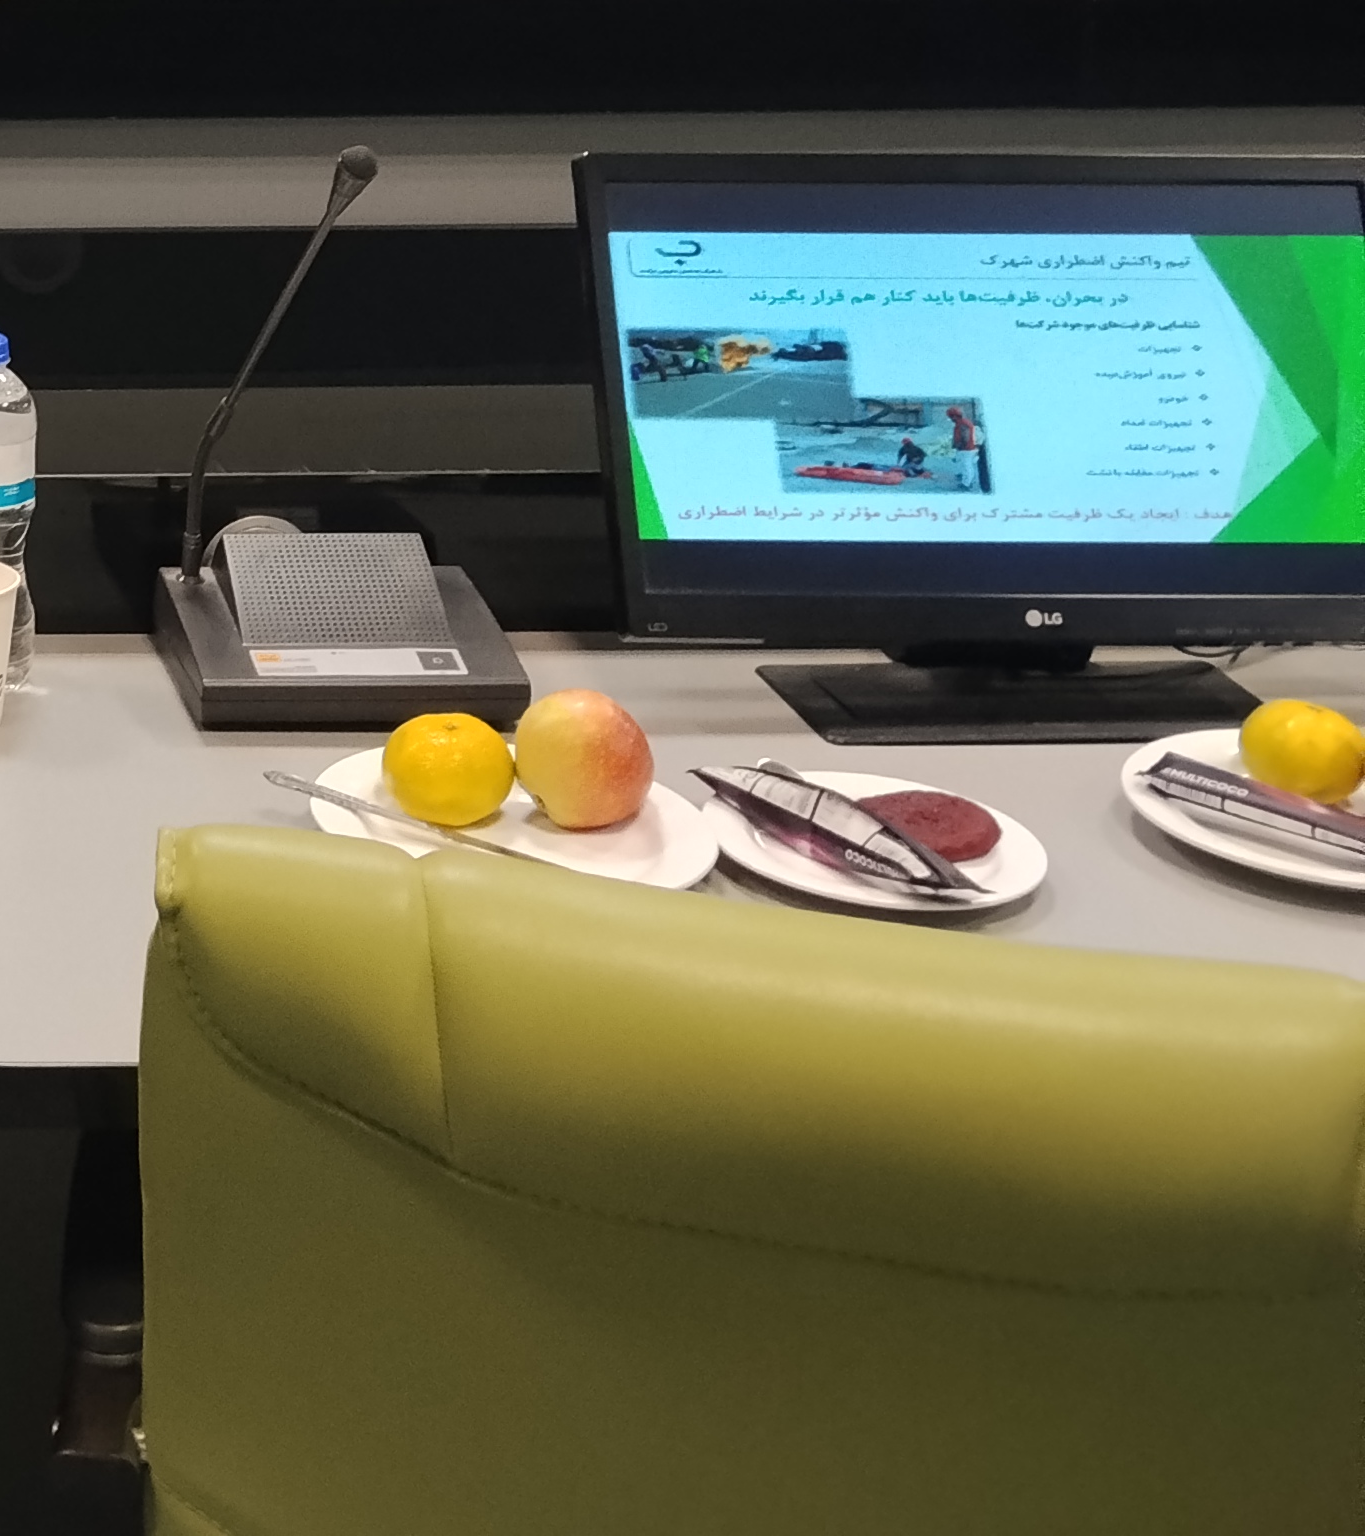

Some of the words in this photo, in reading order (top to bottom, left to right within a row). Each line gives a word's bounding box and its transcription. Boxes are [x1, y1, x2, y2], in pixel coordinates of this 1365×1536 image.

[980, 254, 1034, 270] شهرک
[1037, 254, 1106, 270] اضطراری
[1109, 254, 1162, 271] واکنش
[1165, 255, 1191, 270] تیم
[748, 288, 806, 306] بگیرند
[810, 289, 845, 306] قرار
[850, 292, 877, 306] هم
[882, 289, 917, 306] کنار
[921, 290, 955, 306] باید
[1109, 293, 1129, 308] در
[1158, 320, 1201, 332] شناسایی
[677, 504, 747, 521] اضطراری
[753, 505, 803, 522] شرایط
[807, 508, 825, 522] در
[885, 506, 939, 522] واکنش
[942, 507, 977, 523] برای
[981, 507, 1044, 523] مشترک
[1047, 507, 1103, 523] ظرفیت
[1106, 507, 1136, 522] یک
[1140, 507, 1180, 521] ایجاد
[1193, 508, 1232, 520] هدف
[1172, 768, 1249, 798] MULTICOCO
